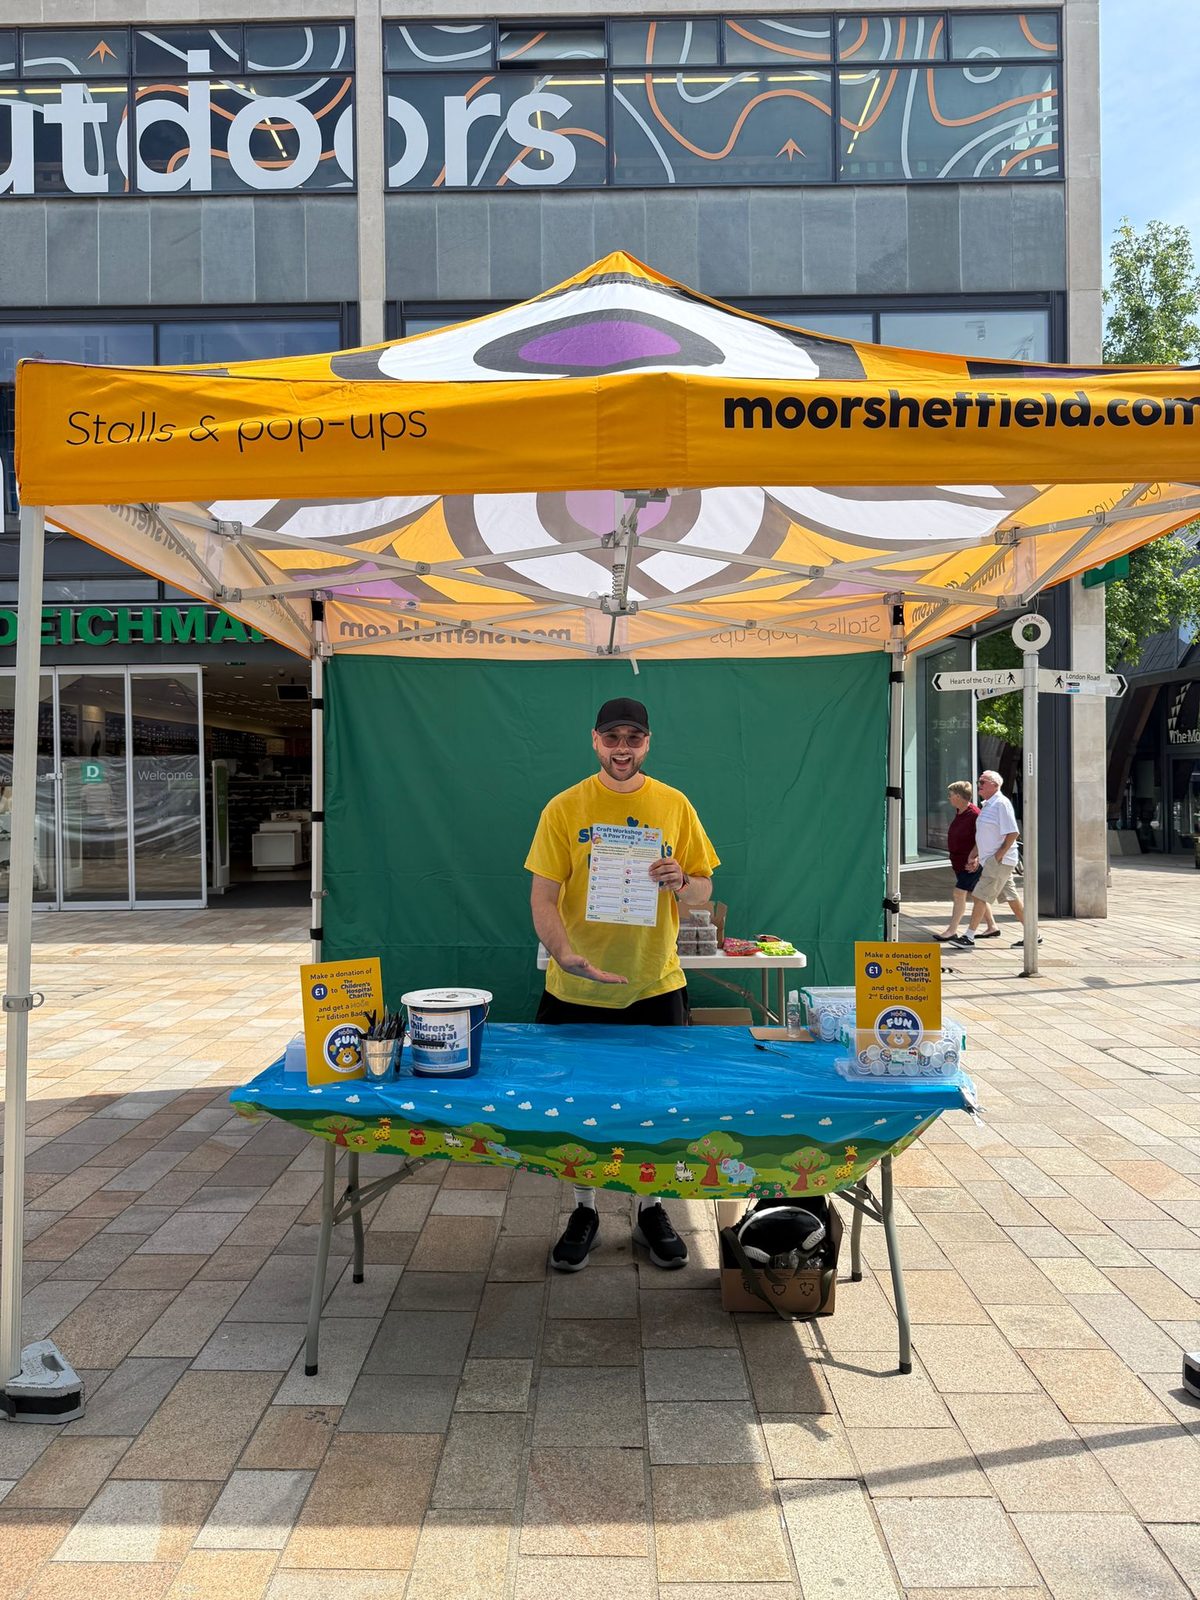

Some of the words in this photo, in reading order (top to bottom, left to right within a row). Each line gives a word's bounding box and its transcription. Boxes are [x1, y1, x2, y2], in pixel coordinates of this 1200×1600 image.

[724, 388, 1200, 430] moorsheffield.com
[66, 410, 177, 447] Stalls
[189, 414, 220, 444] &
[237, 407, 429, 453] pop-ups
[983, 676, 993, 685] City
[1066, 673, 1086, 681] London
[138, 770, 193, 782] Welcome
[613, 828, 643, 836] Workshop
[335, 970, 364, 978] donation
[314, 987, 324, 996] £1
[905, 994, 929, 1002] Badge!
[318, 1004, 331, 1012] and
[332, 1004, 343, 1012] get
[326, 1012, 349, 1021] Edition
[411, 1013, 423, 1021] The
[886, 1016, 913, 1028] FUN
[414, 1030, 457, 1041] Hospital
[334, 1035, 359, 1047] FUN
